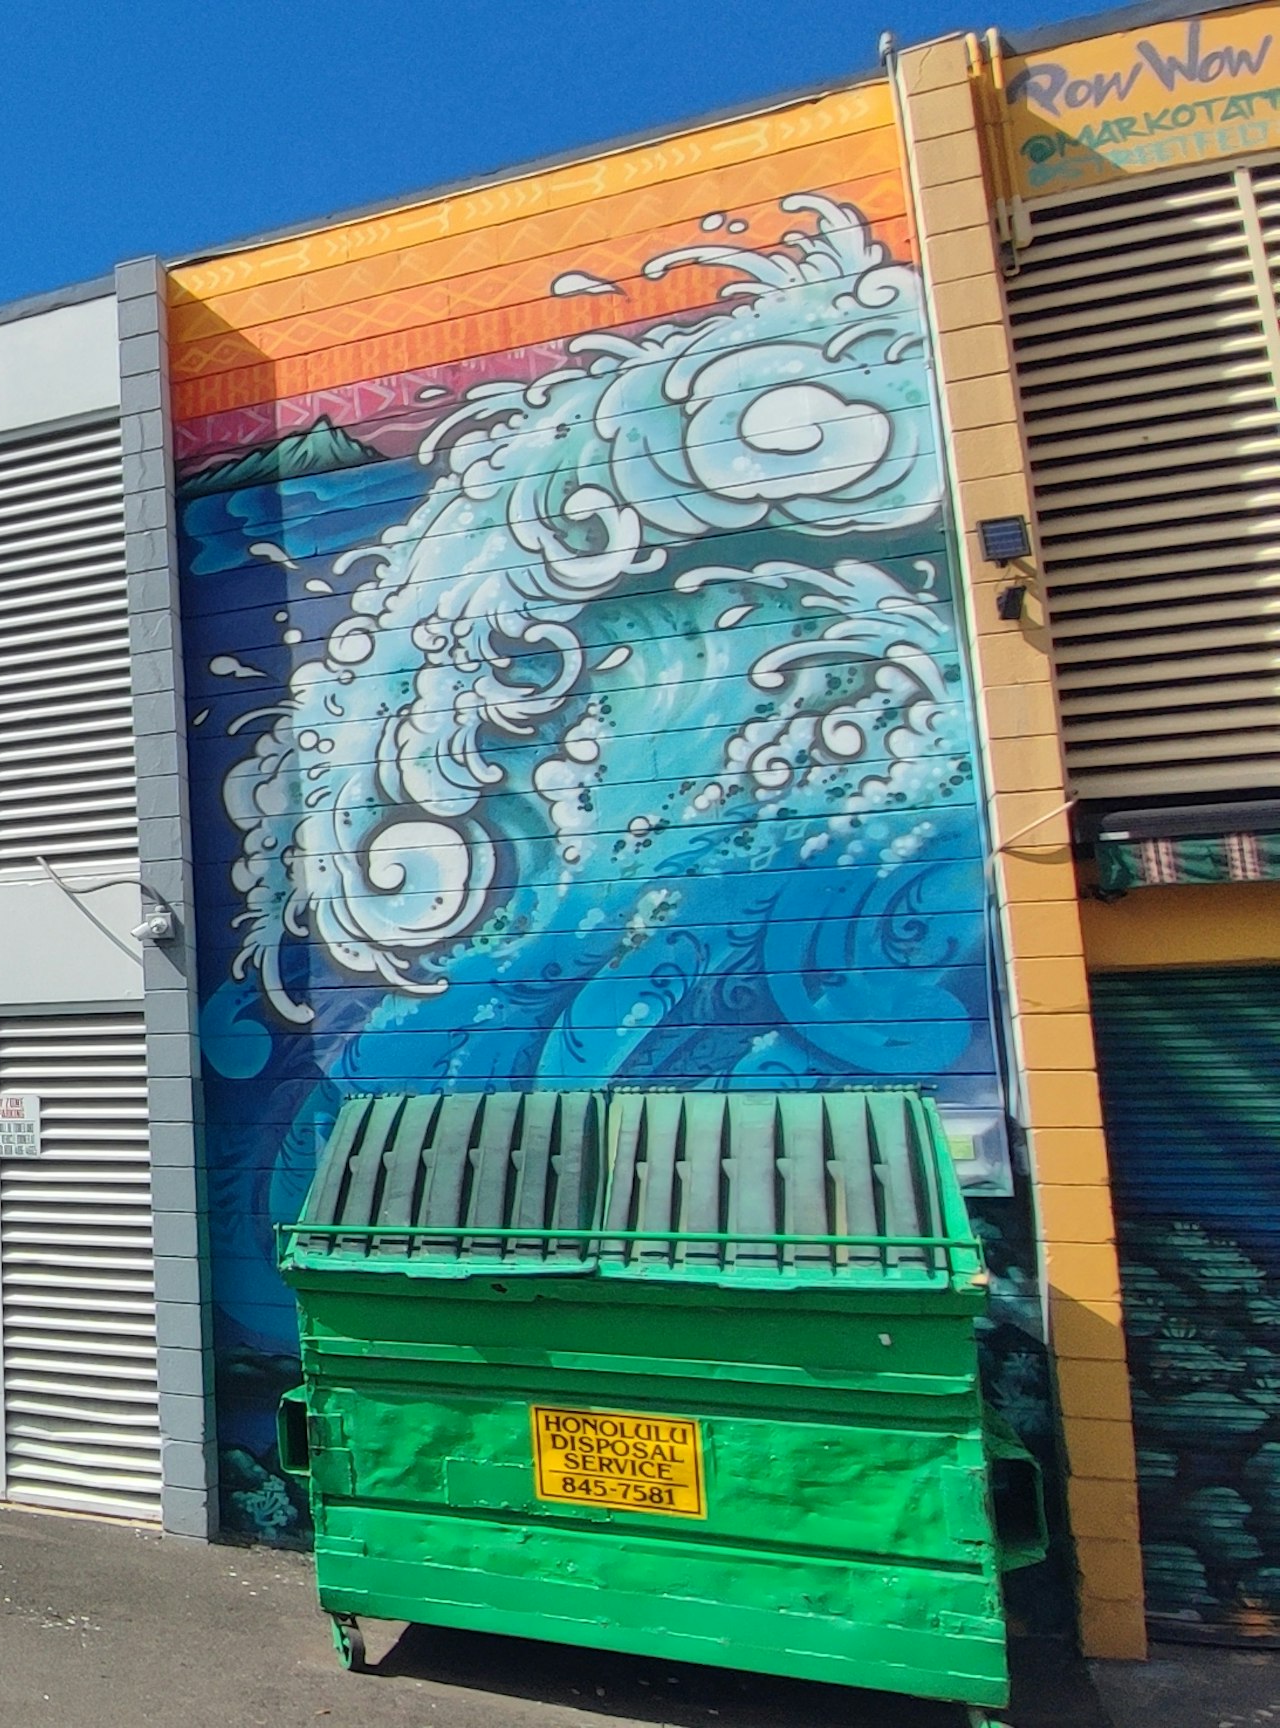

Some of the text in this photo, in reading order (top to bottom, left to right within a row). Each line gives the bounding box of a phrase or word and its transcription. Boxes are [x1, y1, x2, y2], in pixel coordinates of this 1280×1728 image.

[545, 1415, 688, 1445] HONOLULU
[551, 1434, 684, 1463] DISPOSAL
[564, 1453, 673, 1481] SERVICE
[562, 1477, 676, 1505] 845-7581
